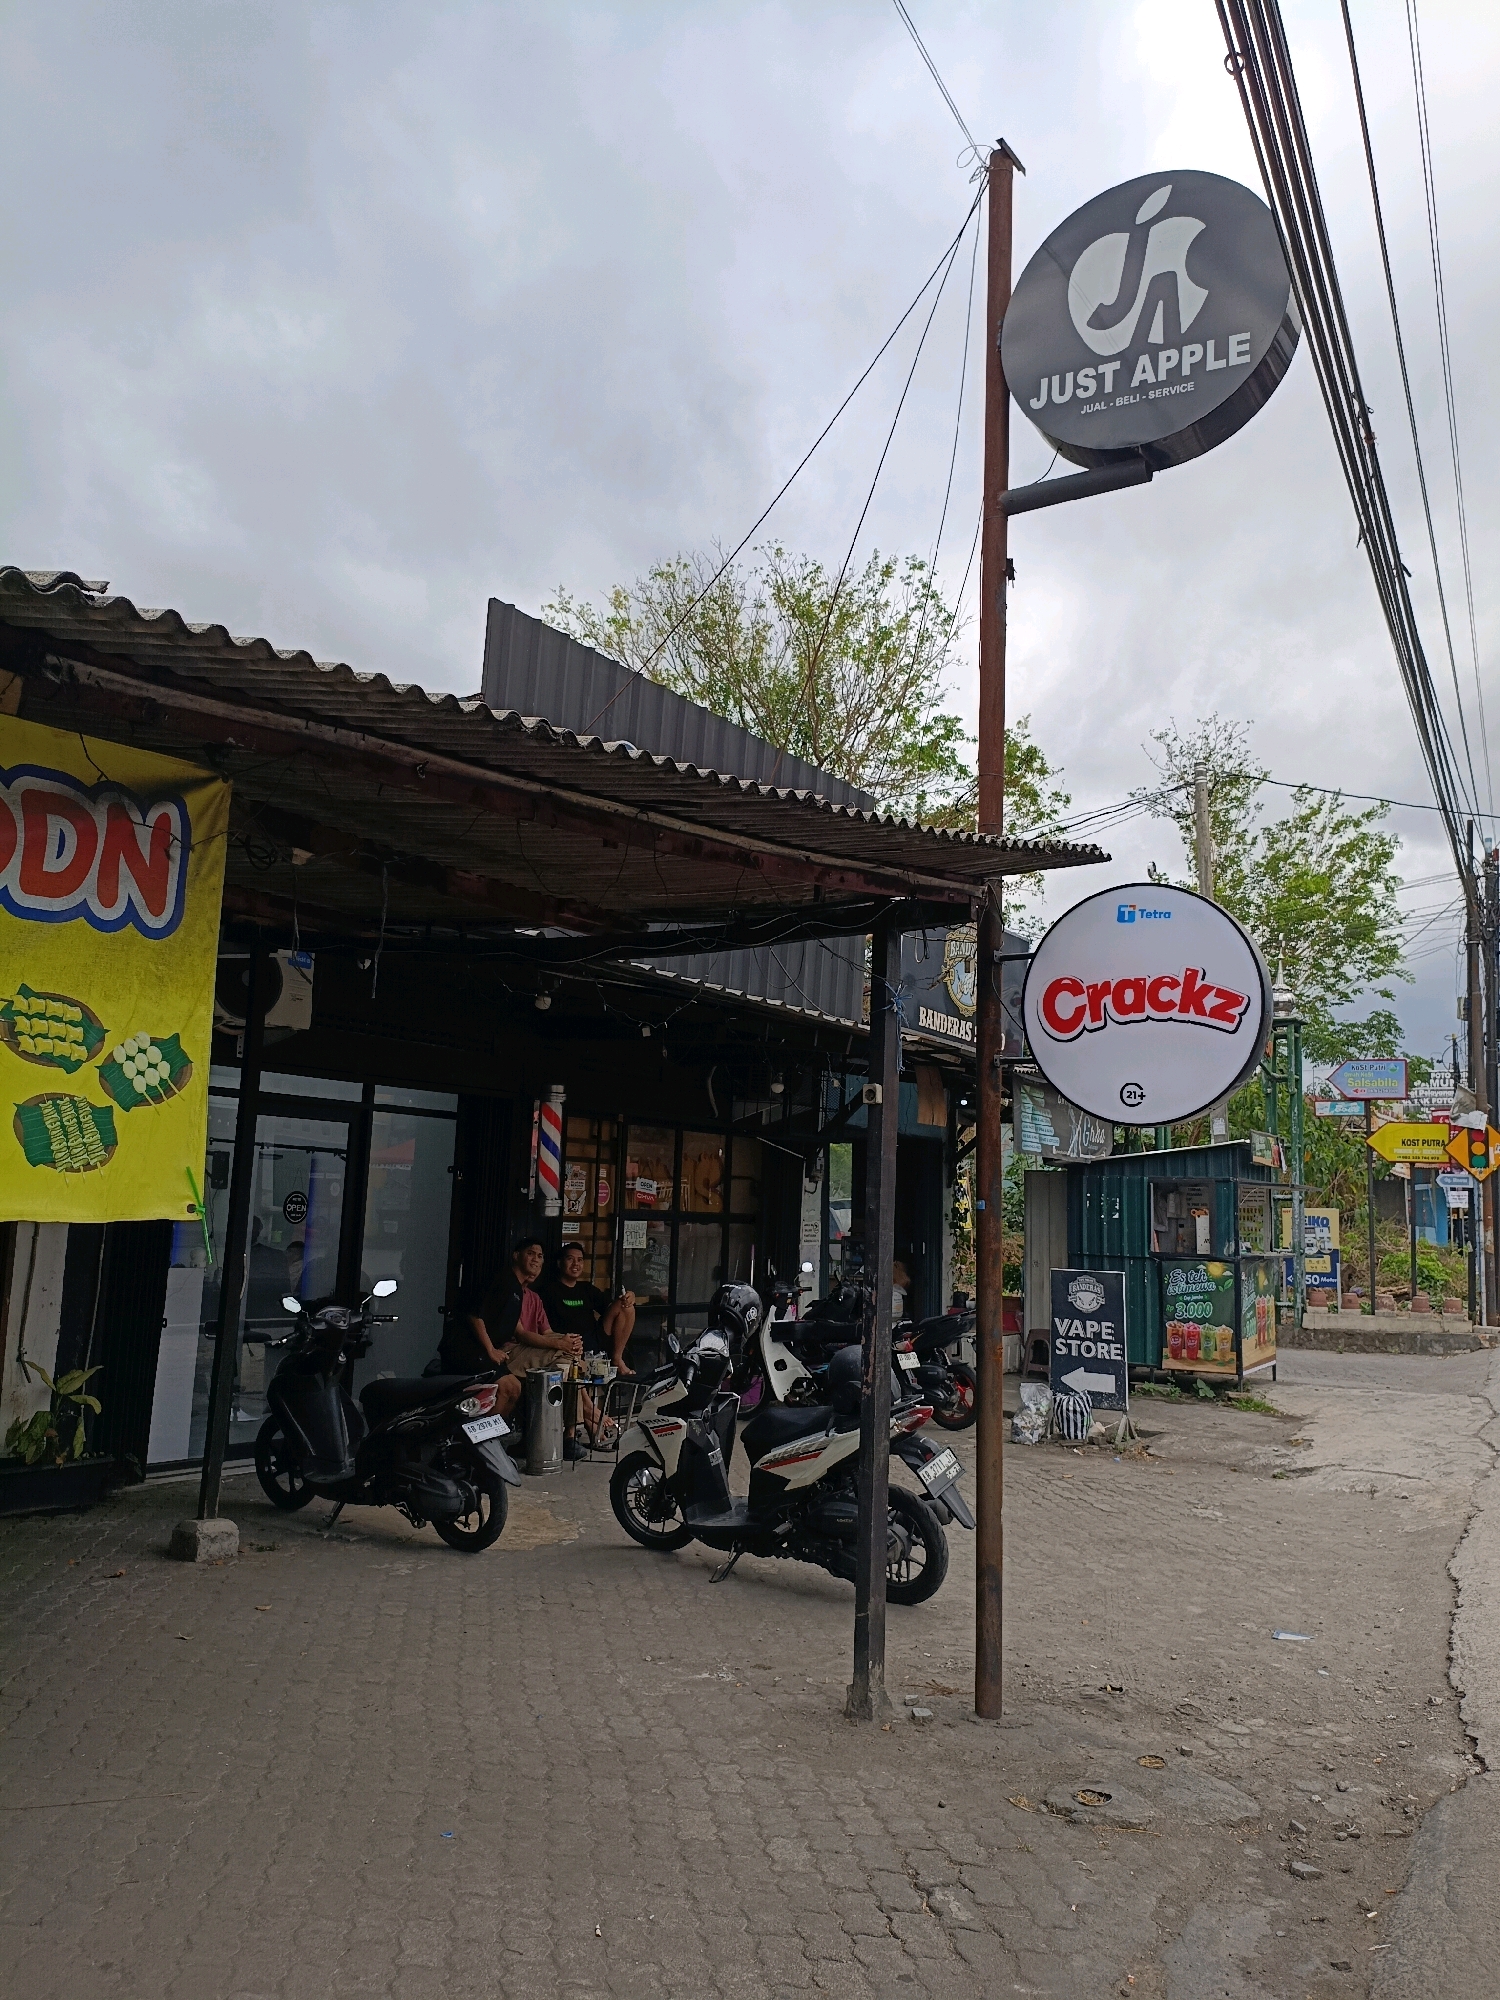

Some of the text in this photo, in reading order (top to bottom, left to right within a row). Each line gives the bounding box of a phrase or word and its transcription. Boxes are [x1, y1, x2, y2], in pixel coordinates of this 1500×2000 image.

[1029, 332, 1251, 410] JUST APPLE
[1080, 401, 1107, 414] JUAL
[1116, 395, 1140, 407] BELI
[1148, 382, 1195, 399] SERVICE
[0, 770, 185, 935] DN
[1139, 908, 1172, 919] Tetra
[1041, 967, 1246, 1036] Crackz
[918, 1006, 973, 1042] BANDERAS
[1347, 1078, 1399, 1087] Salsabila
[1126, 1090, 1146, 1101] 21+
[1402, 1139, 1446, 1147] KOST PUTRA
[286, 1204, 307, 1212] OPEN
[1169, 1269, 1208, 1284] Es teh
[1072, 1283, 1101, 1294] BANDERAS
[1174, 1302, 1213, 1320] 3.000
[1054, 1317, 1114, 1341] VAPE
[1056, 1337, 1124, 1361] STORE
